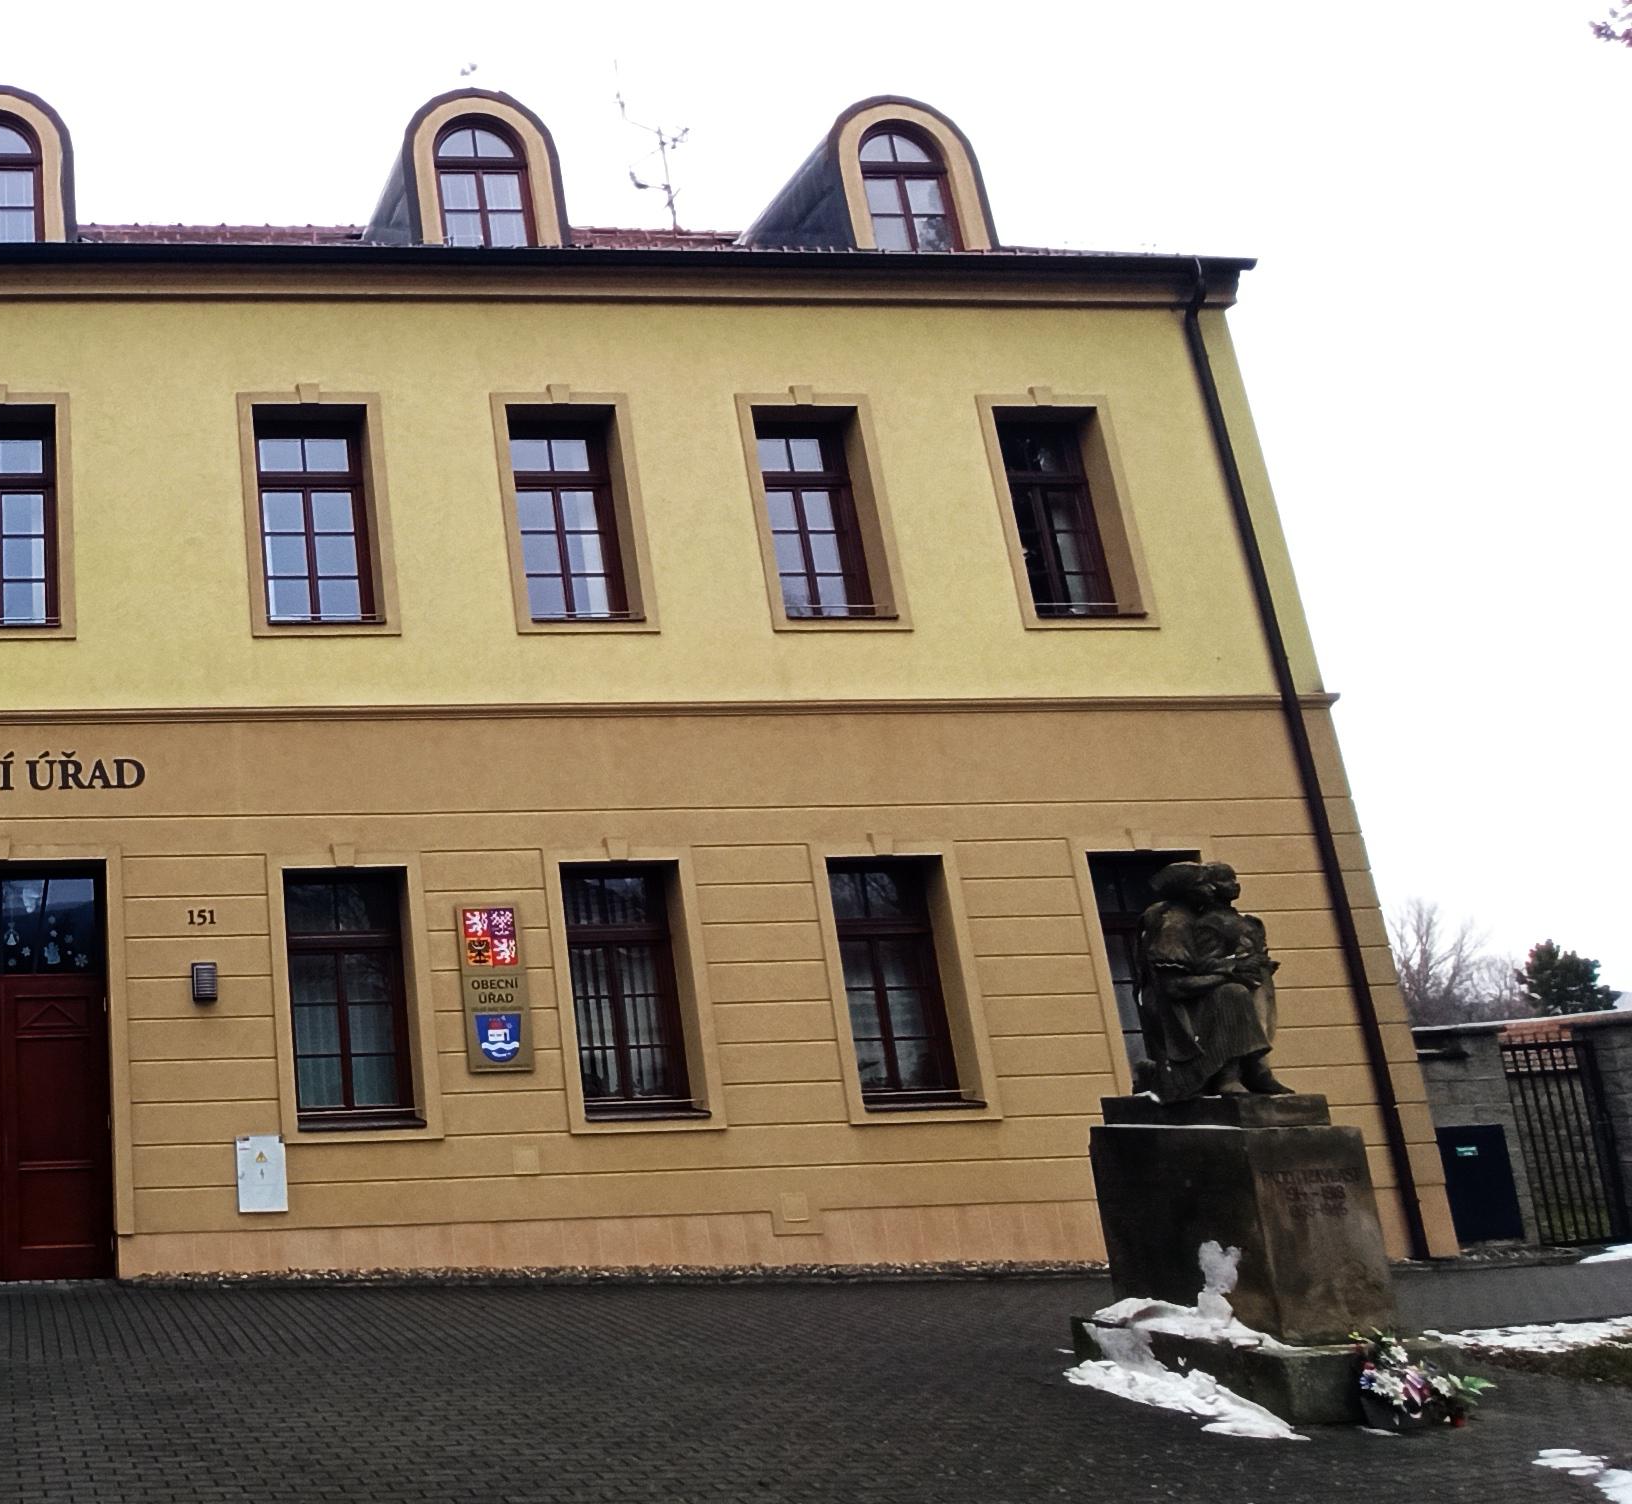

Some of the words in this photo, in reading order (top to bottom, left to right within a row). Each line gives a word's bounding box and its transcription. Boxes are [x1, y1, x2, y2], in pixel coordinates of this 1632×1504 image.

[26, 751, 146, 790] ÚŘAD
[187, 909, 216, 926] 151
[471, 976, 518, 990] OBECNÍ
[478, 991, 514, 1004] ÚŘAD
